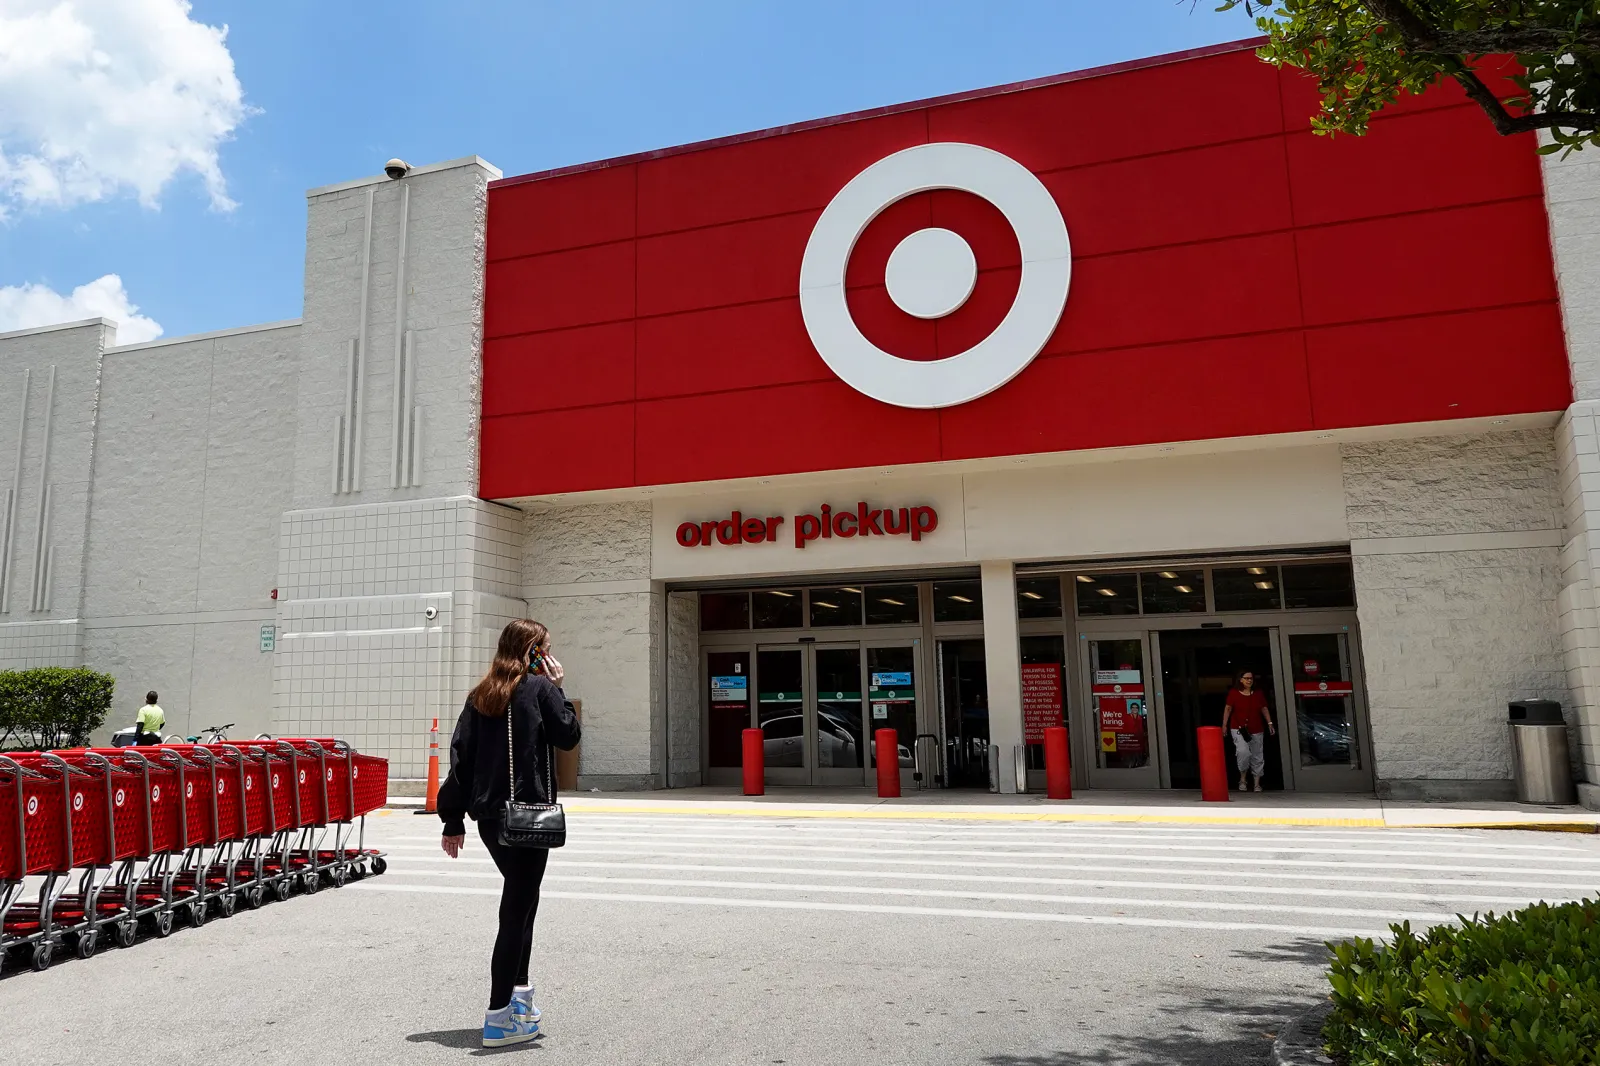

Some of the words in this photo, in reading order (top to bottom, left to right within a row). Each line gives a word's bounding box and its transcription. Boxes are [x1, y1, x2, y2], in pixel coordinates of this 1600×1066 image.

[676, 511, 783, 547] order
[794, 502, 938, 549] pickup
[1103, 718, 1124, 726] hiring.
